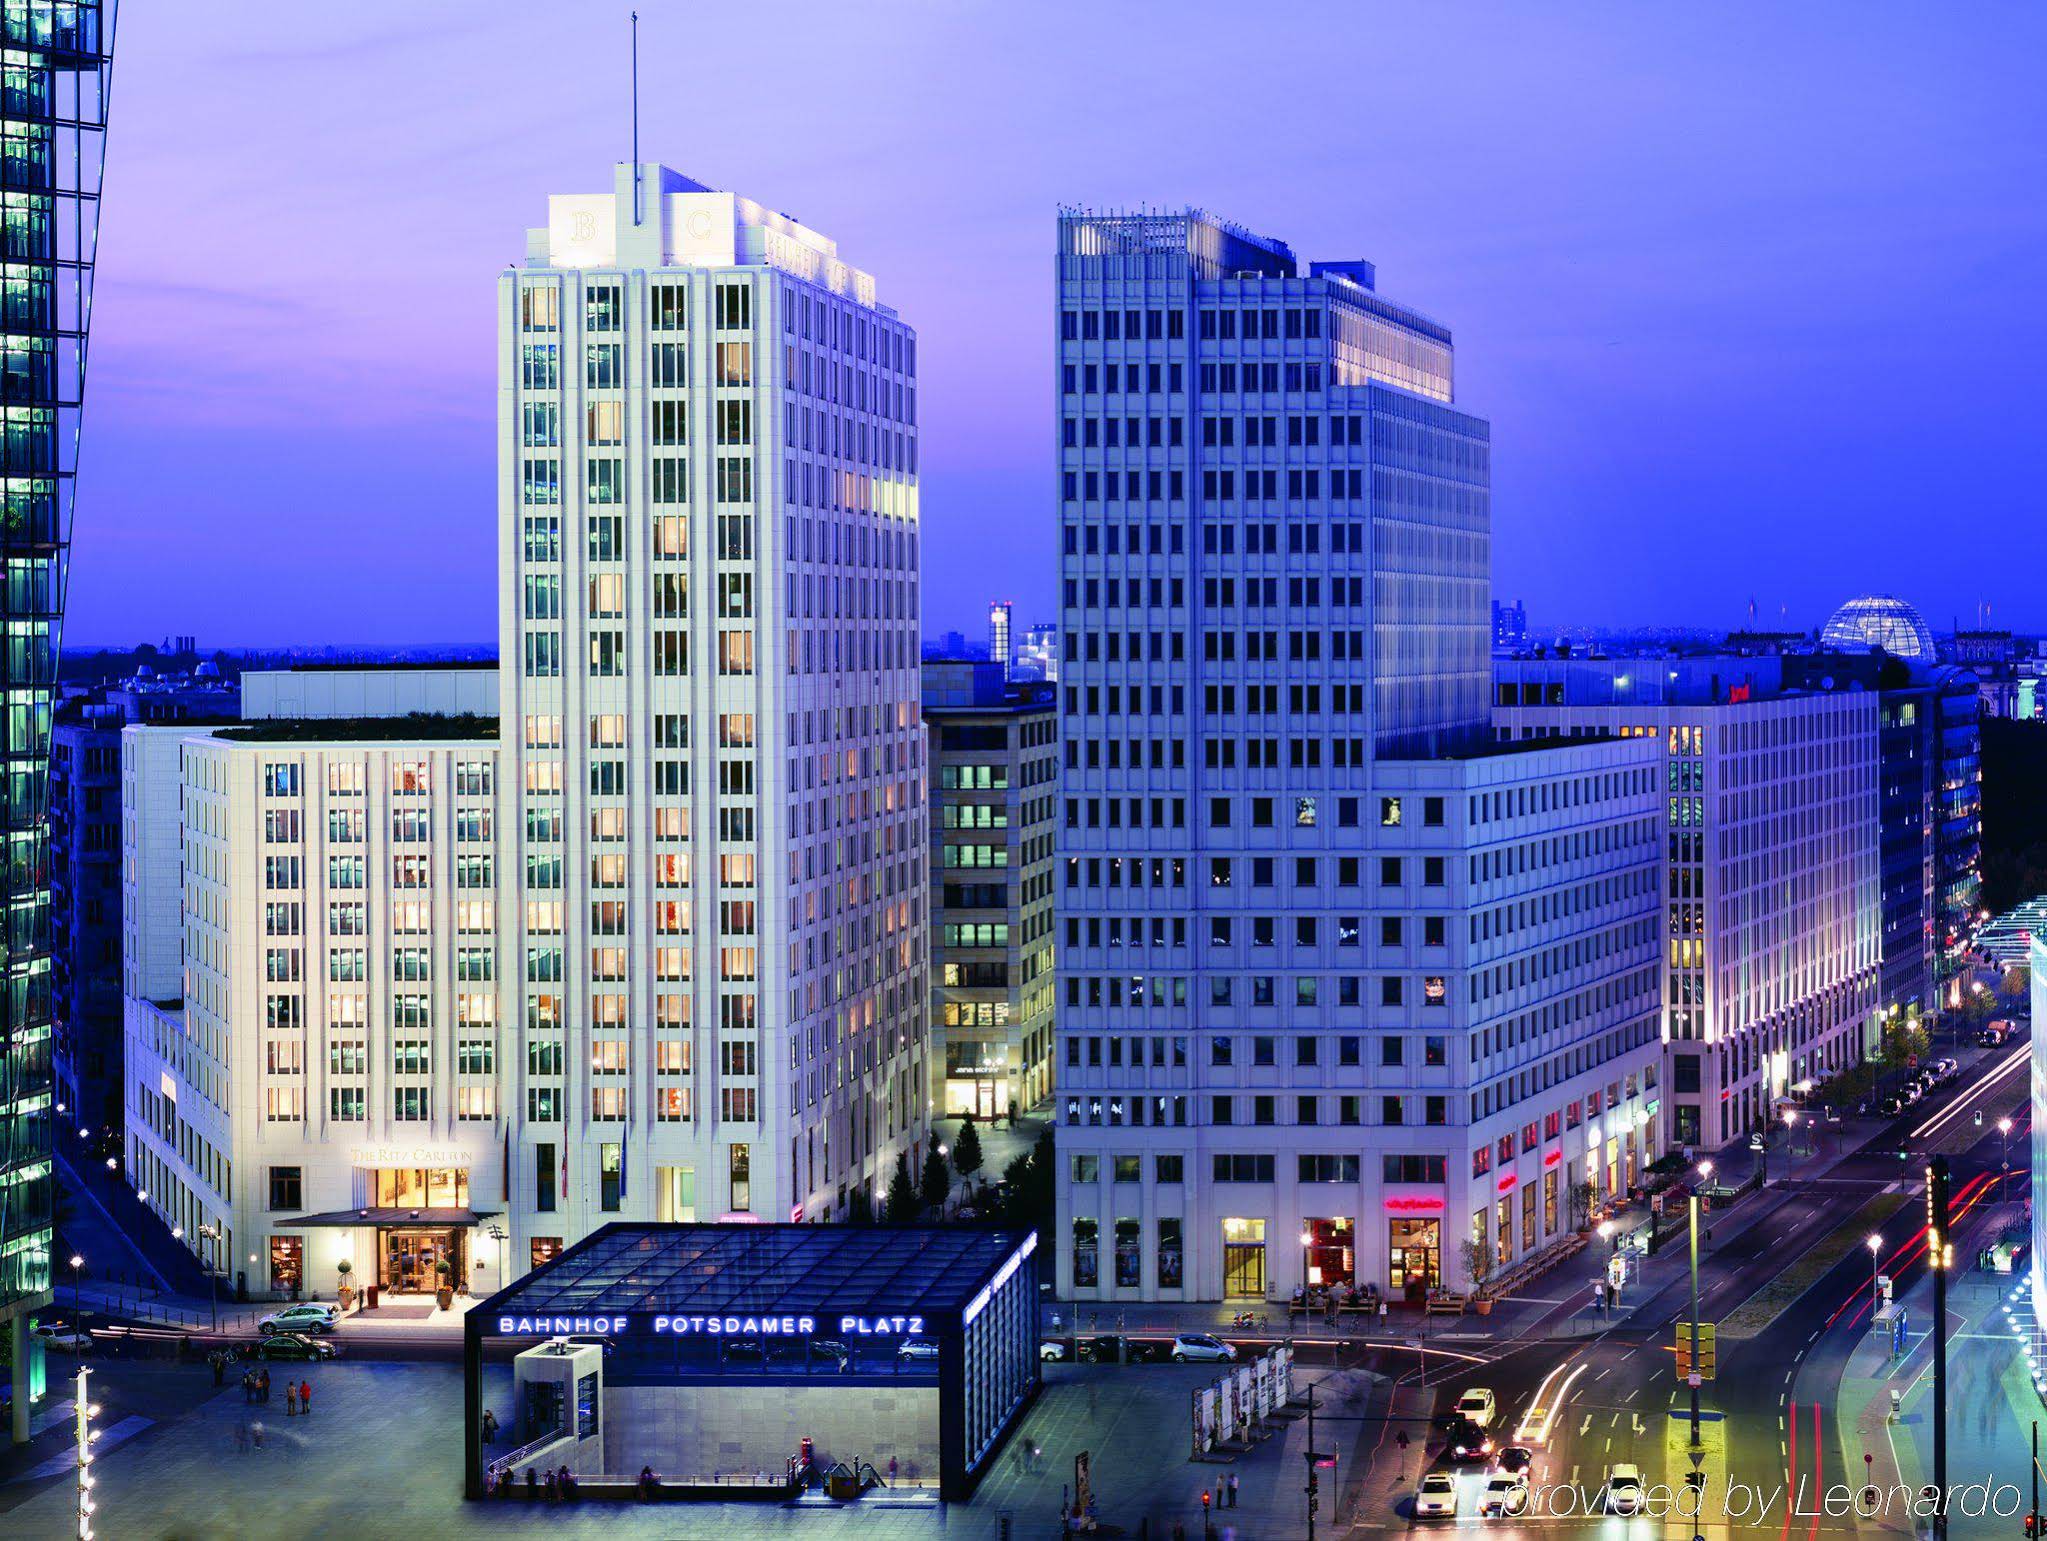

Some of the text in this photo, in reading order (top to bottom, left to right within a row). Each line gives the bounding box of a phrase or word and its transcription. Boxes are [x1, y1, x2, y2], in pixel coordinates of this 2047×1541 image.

[571, 211, 598, 241] B
[688, 210, 712, 240] C
[1752, 1133, 1761, 1144] S
[351, 1149, 376, 1161] THE
[500, 1318, 924, 1332] BAHNHOF POTSDAMER PLATZ
